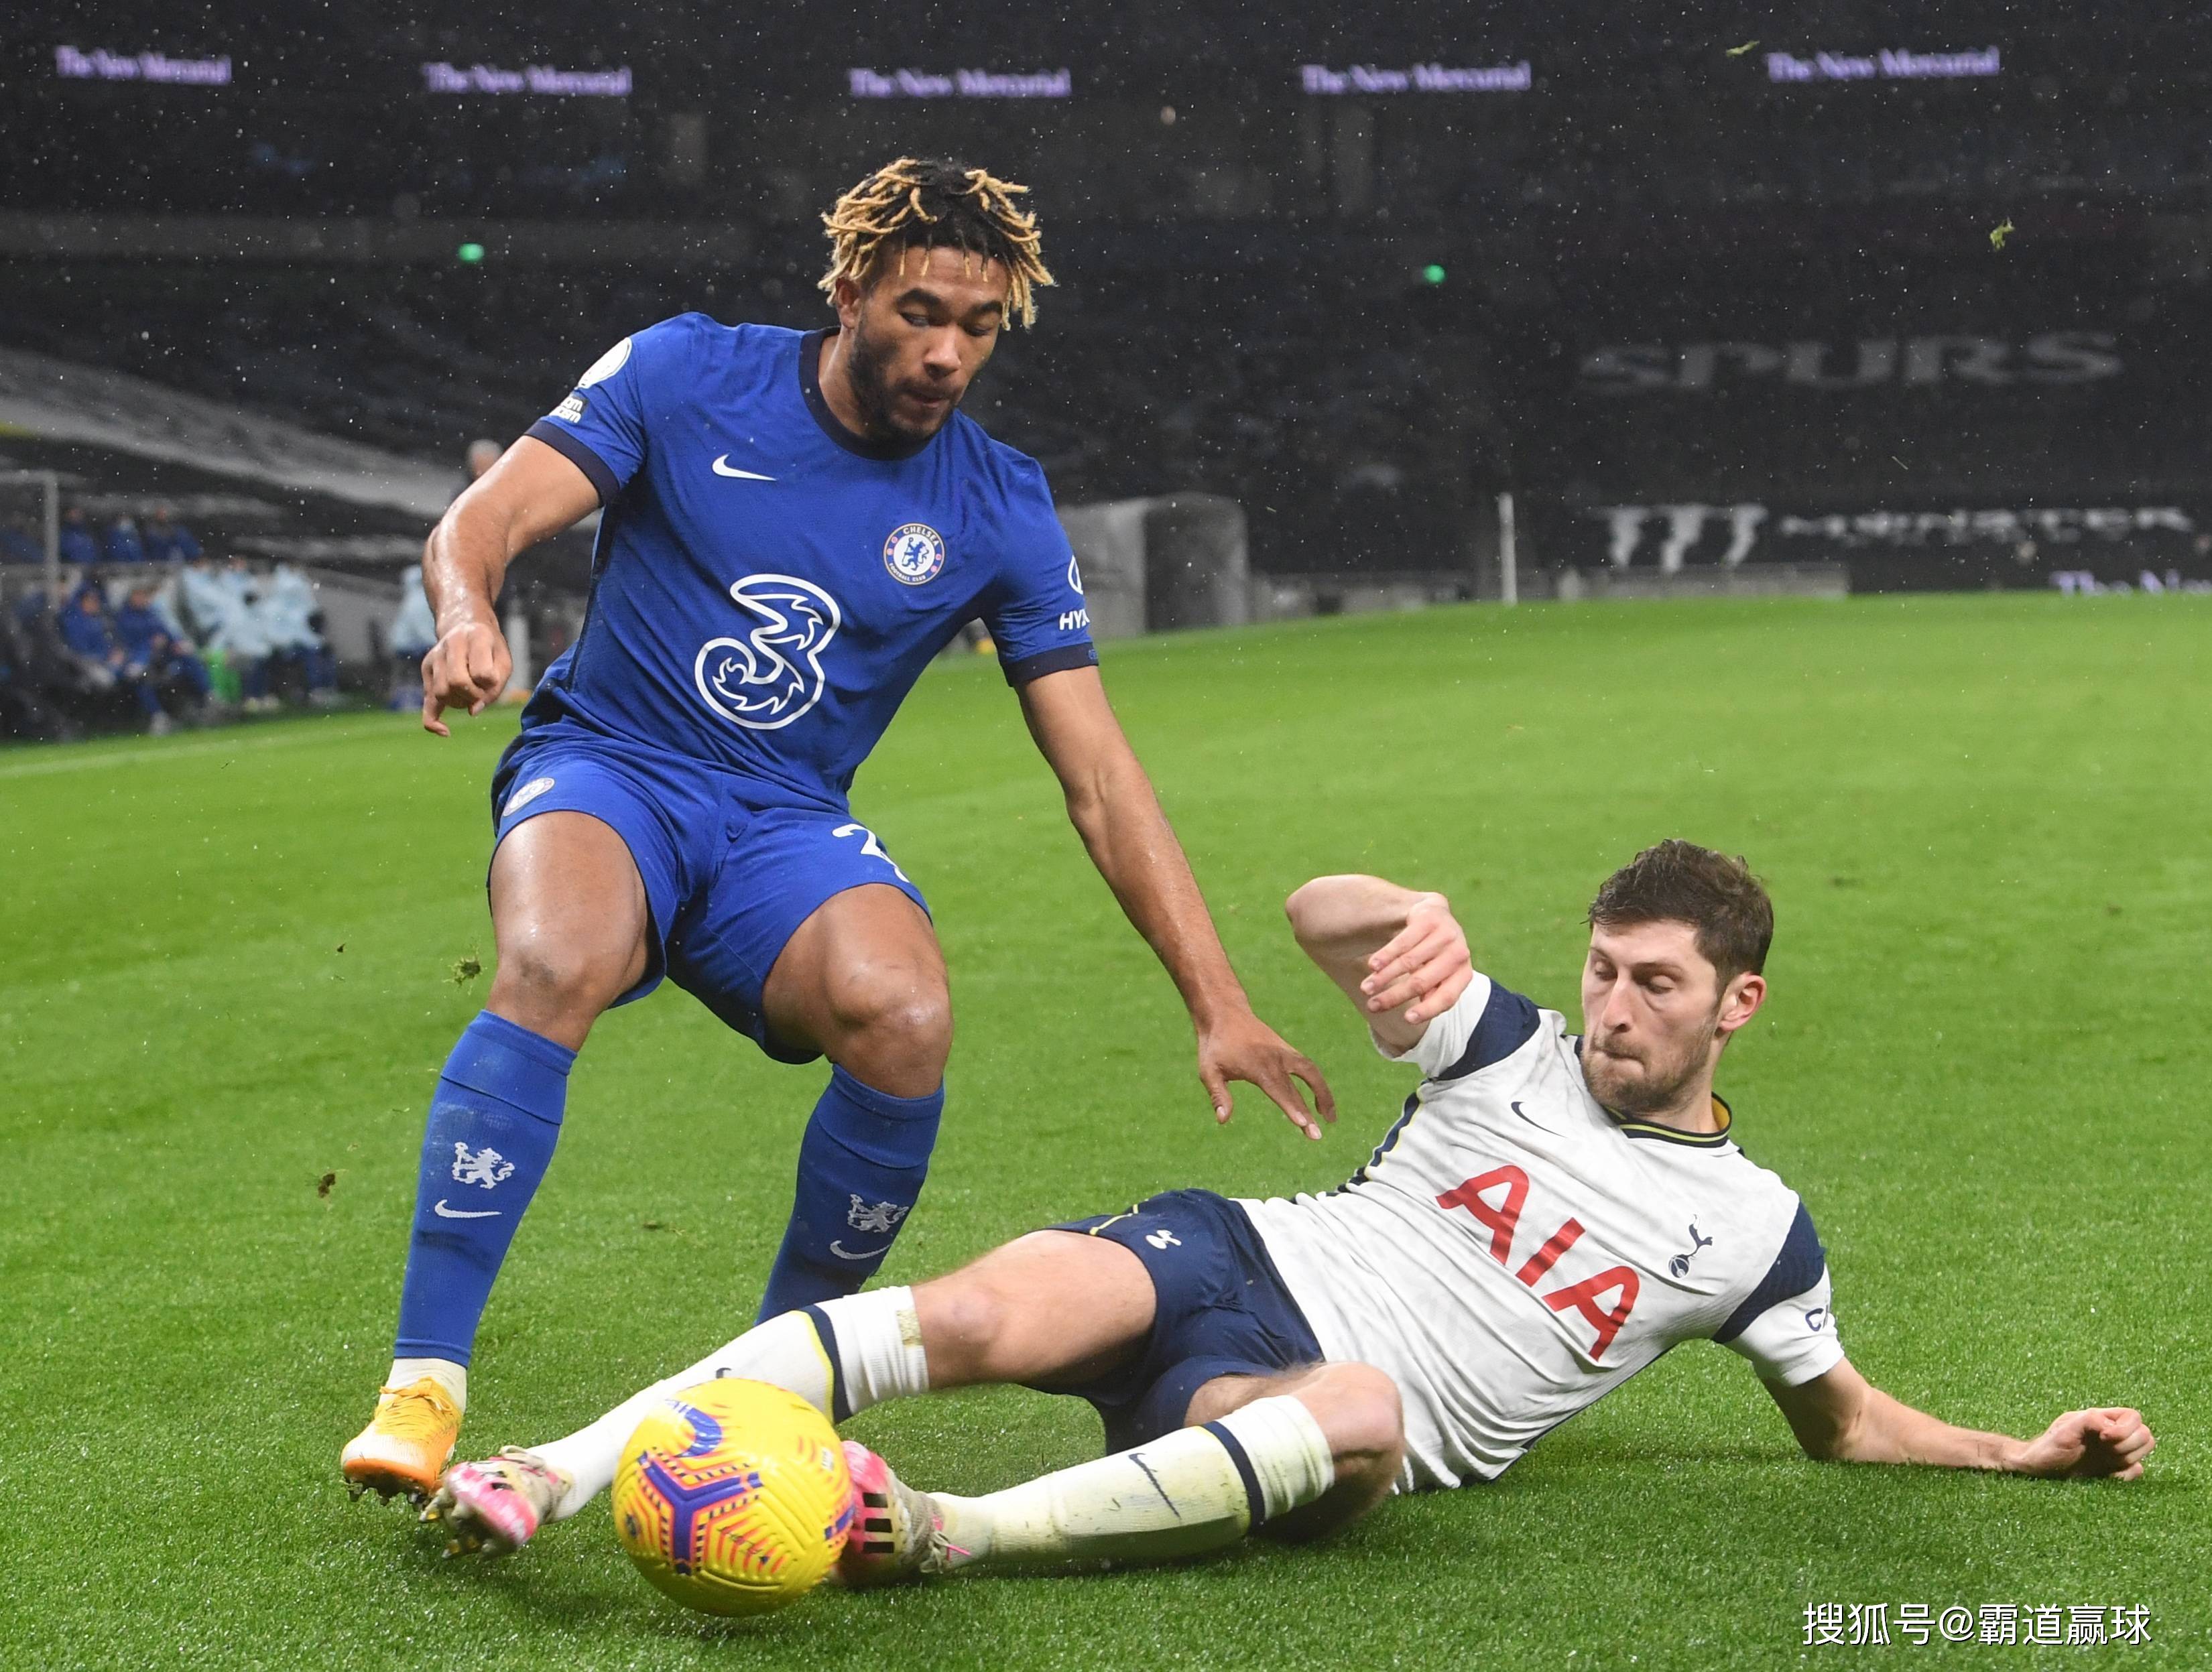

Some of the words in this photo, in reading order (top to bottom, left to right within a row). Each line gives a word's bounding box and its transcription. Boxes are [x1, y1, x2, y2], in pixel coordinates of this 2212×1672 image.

[1579, 330, 2124, 394] SPURS
[903, 526, 939, 546] CHELSEA
[1435, 1165, 1640, 1362] AIA
